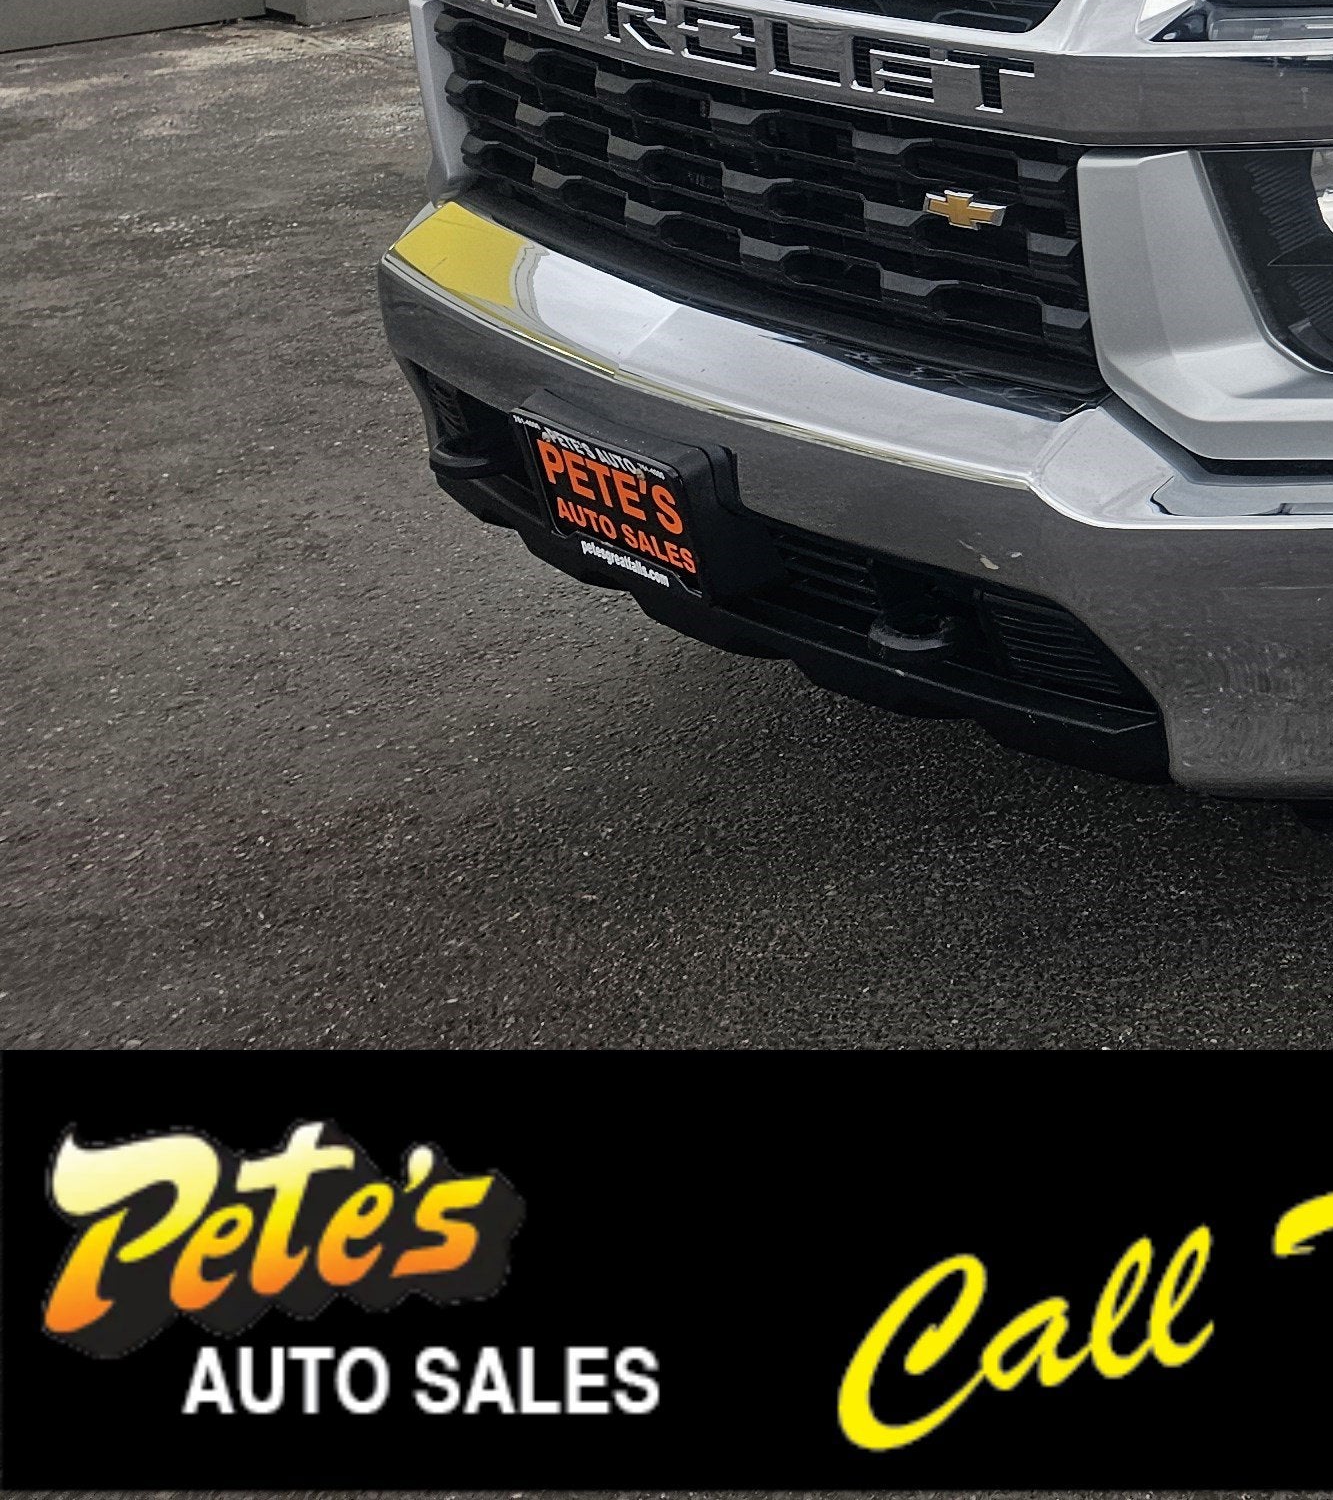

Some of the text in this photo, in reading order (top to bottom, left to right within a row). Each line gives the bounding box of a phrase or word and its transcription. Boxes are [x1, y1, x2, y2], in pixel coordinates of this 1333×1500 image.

[537, 438, 683, 535] PETE'S
[595, 446, 637, 475] AUTO
[556, 496, 697, 574] AUTO SALES
